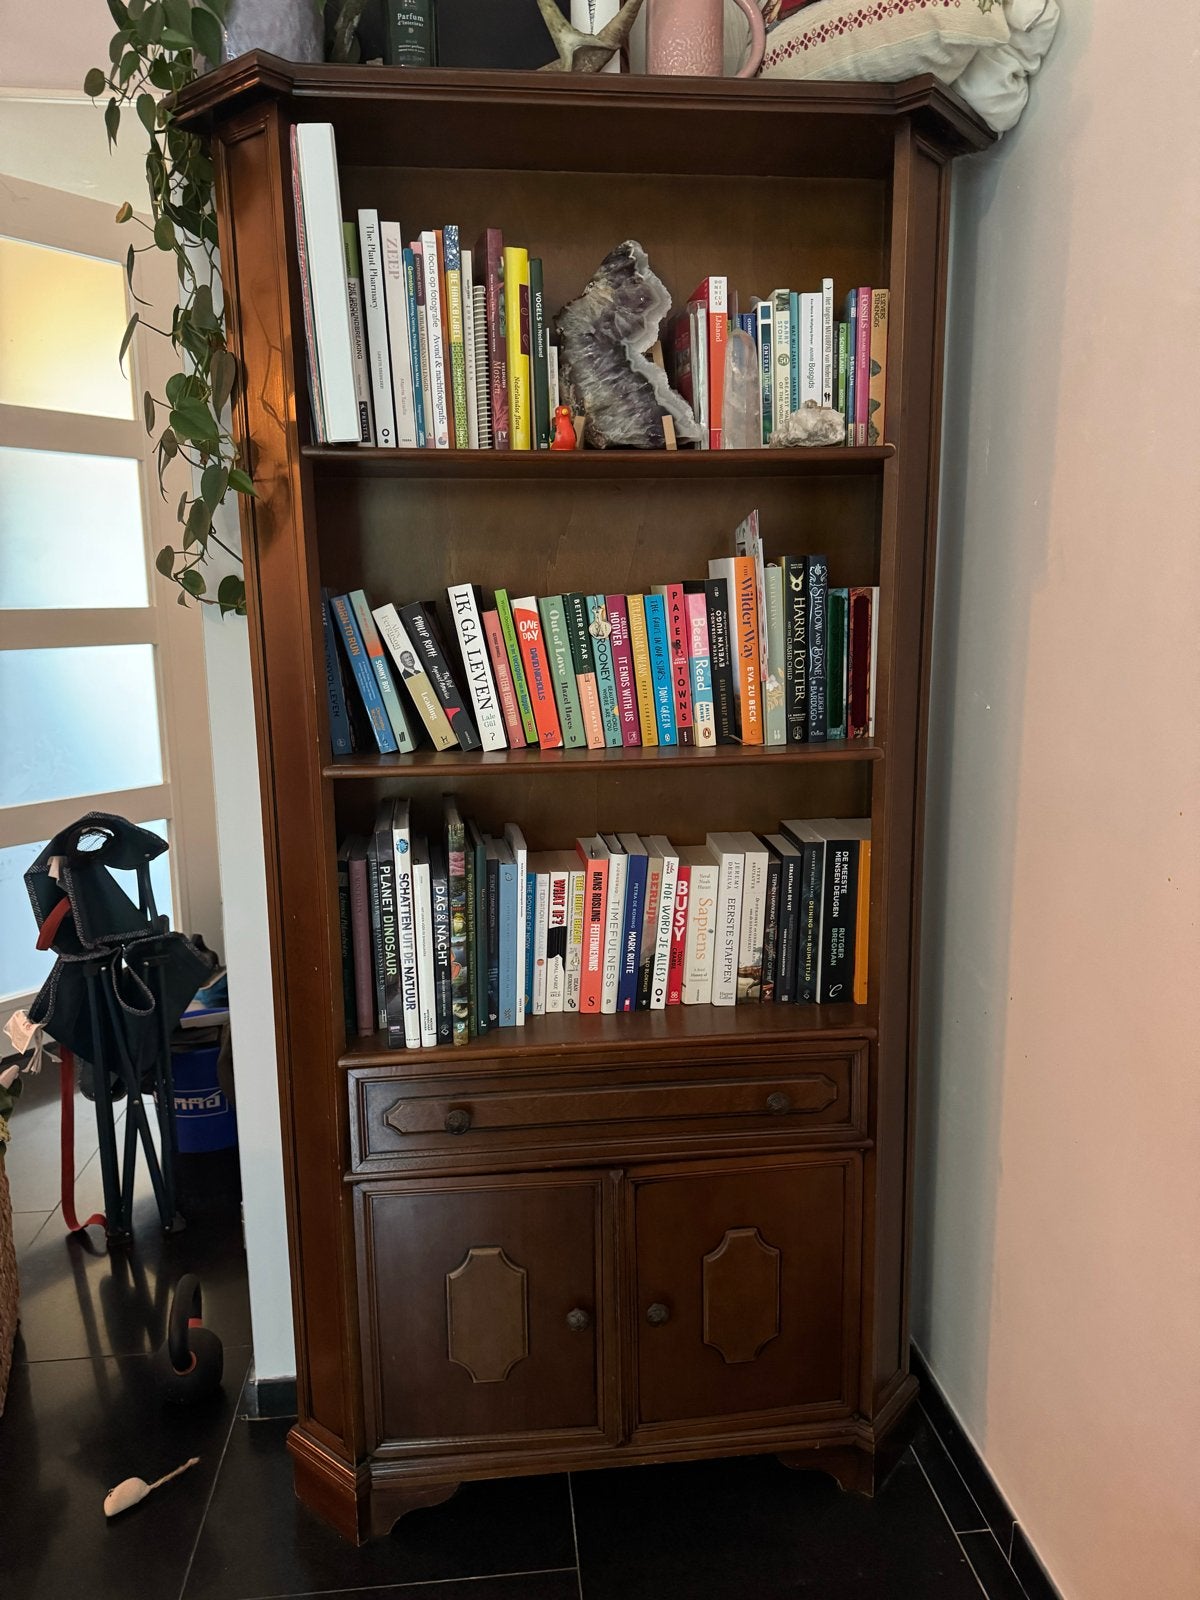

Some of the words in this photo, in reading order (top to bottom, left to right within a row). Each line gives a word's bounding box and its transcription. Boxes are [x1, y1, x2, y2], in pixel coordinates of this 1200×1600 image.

[397, 12, 424, 22] Parfum
[366, 224, 376, 243] The
[367, 245, 377, 267] Plant
[386, 238, 400, 279] ZEEP
[428, 253, 436, 275] focus
[369, 269, 379, 310] Pharmacy
[407, 265, 415, 297] Gemstone
[428, 277, 436, 288] op
[430, 289, 440, 328] fotografie
[451, 286, 460, 340] HAAKBIJBEL
[861, 294, 869, 329] FOSSILS
[433, 334, 442, 360] Avond
[434, 360, 442, 368] &
[779, 357, 787, 365] 50
[493, 361, 502, 395] Mossen
[806, 363, 816, 389] Bosgids
[435, 370, 447, 425] nachtfotografie
[514, 376, 522, 414] Nederlandse
[515, 414, 523, 431] flora
[335, 599, 349, 624] BORN
[454, 591, 472, 615] IK
[573, 598, 584, 628] BETTER
[650, 599, 660, 613] THE
[741, 577, 753, 628] Wilder
[812, 586, 825, 633] SHADOW
[344, 625, 354, 637] TO
[381, 615, 401, 651] Ferguson
[460, 619, 478, 646] GA
[519, 620, 539, 633] ONE
[549, 609, 560, 634] Out
[610, 611, 623, 647] HOOVER
[620, 616, 629, 639] COLLEEN
[630, 598, 646, 653] EXTRAORDINARY
[672, 591, 682, 651] PAPER
[715, 610, 723, 634] HUGO
[793, 597, 806, 644] HARRY
[348, 636, 361, 656] RUN
[412, 615, 430, 638] PHILIP
[421, 639, 438, 658] ROTH
[522, 630, 539, 642] DAY
[553, 635, 563, 647] of
[578, 630, 586, 641] BY
[692, 618, 708, 656] Beach
[740, 629, 755, 660] Way
[530, 648, 540, 669] DAVID
[555, 648, 567, 676] Love
[580, 643, 588, 660] FAR
[596, 638, 612, 682] ROONEY
[618, 656, 628, 664] IT
[655, 646, 664, 657] OUR
[717, 637, 726, 668] EVELYN
[811, 645, 823, 676] BONE
[375, 659, 387, 680] SONNY
[382, 680, 391, 693] BOY
[466, 648, 494, 711] LEVEN
[619, 665, 630, 688] ENDS
[636, 655, 648, 678] MEANS
[656, 659, 666, 680] STARS
[694, 659, 711, 691] Read
[746, 666, 755, 682] EVA
[793, 649, 806, 704] POTTER
[533, 669, 546, 702] NICHOLLS
[560, 681, 571, 705] Hazel
[658, 686, 668, 703] JOHN
[677, 666, 687, 721] TOWNS
[747, 685, 757, 697] ZU
[420, 691, 439, 720] Leading
[622, 689, 633, 710] WITH
[748, 699, 757, 723] BECK
[810, 685, 818, 721] BARDUGO
[481, 713, 496, 723] Lale
[564, 706, 573, 730] Hayes
[624, 711, 635, 722] US
[660, 705, 672, 729] GREEN
[833, 851, 841, 884] MENSEN
[842, 851, 849, 862] DE
[380, 865, 394, 913] PLANET
[552, 878, 566, 907] WHAT
[575, 874, 584, 891] THE
[592, 871, 603, 891] HANS
[664, 883, 674, 901] HOE
[398, 872, 412, 931] SCHATTEN
[435, 886, 446, 912] DAG
[574, 894, 583, 916] IDIOT
[590, 893, 602, 922] ROSLING
[646, 871, 660, 925] BERLIJN
[672, 880, 688, 942] BUSY
[832, 886, 840, 917] DEUGEN
[435, 914, 446, 922] &
[551, 909, 566, 925] IF?
[660, 905, 671, 935] WORD
[694, 897, 713, 960] Sapiens
[726, 898, 736, 937] EERSTE
[402, 932, 413, 949] UIT
[572, 917, 582, 945] BRAIN
[605, 901, 620, 988] TIMEFULNESS
[626, 931, 638, 952] MARK
[658, 936, 668, 949] JE
[837, 927, 845, 959] RUTGER
[383, 915, 398, 976] DINOSAUR
[403, 952, 414, 965] DE
[436, 924, 448, 967] NACHT
[588, 923, 601, 972] FEITENKENNIS
[830, 927, 838, 966] BREGMAN
[625, 953, 636, 974] RUTTE
[655, 952, 668, 983] ALLES?
[723, 939, 734, 985] STAPPEN
[403, 966, 417, 1011] NATUUR
